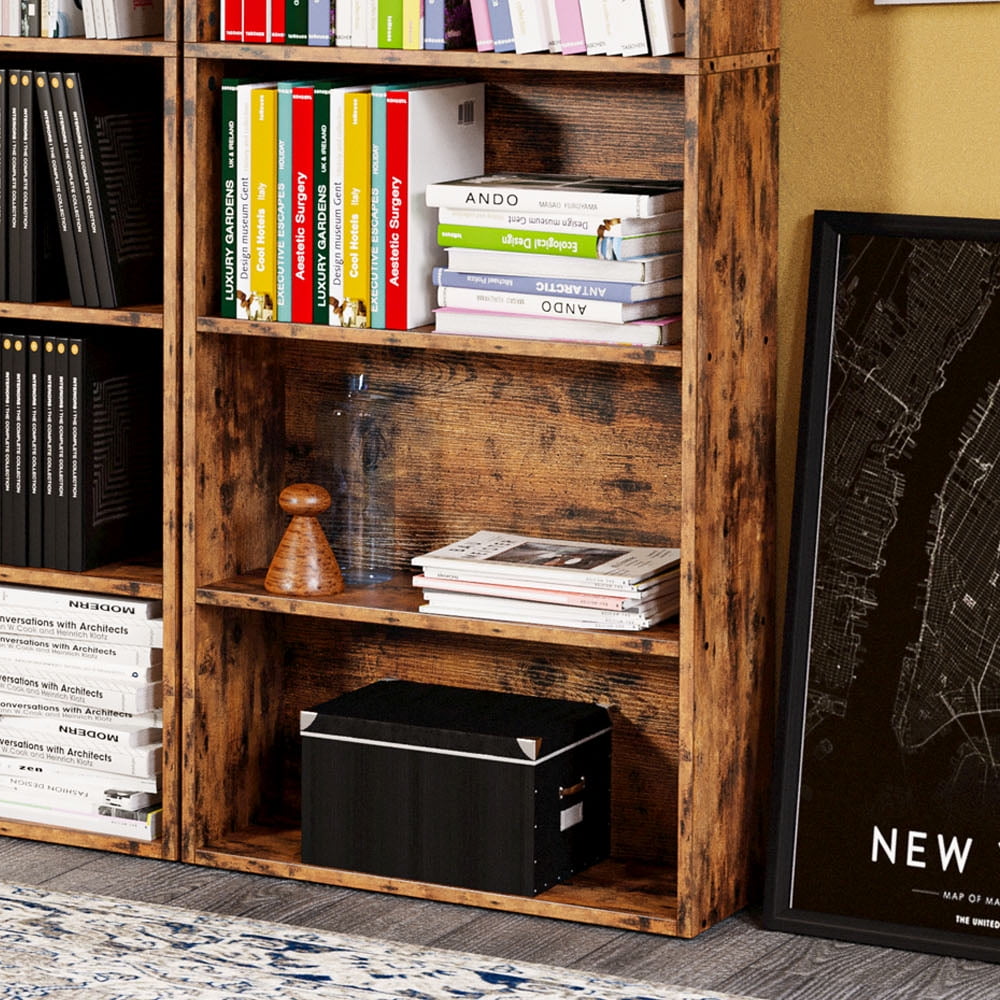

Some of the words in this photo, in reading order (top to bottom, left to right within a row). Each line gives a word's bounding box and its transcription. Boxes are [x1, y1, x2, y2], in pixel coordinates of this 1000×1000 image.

[81, 161, 90, 194] COMPLETE
[86, 195, 97, 233] COLLECTION
[241, 177, 249, 201] Gent
[295, 172, 308, 223] Surgery
[465, 192, 519, 206] ANDO
[225, 180, 234, 244] GARDENS
[390, 176, 402, 229] Surgery
[241, 204, 249, 247] museum
[318, 185, 327, 250] GARDENS
[371, 188, 379, 243] ESCAPES
[507, 215, 527, 225] Gent
[529, 217, 560, 226] museum
[562, 219, 588, 230] Design
[256, 209, 265, 244] Hotels
[501, 235, 531, 249] Design
[534, 238, 578, 253] Ecological
[256, 246, 265, 272] Cool
[295, 226, 306, 280] Aestetic
[389, 232, 400, 287] Aestetic
[225, 248, 234, 300] LUXURY
[241, 249, 251, 279] Design
[318, 254, 327, 307] LUXURY
[371, 247, 379, 313] EXECUTIVE
[536, 281, 606, 297] ANTARCTIC
[541, 300, 587, 316] ANDO
[69, 600, 135, 614] MODERN
[57, 617, 77, 629] with
[79, 621, 129, 634] Architects
[41, 679, 58, 691] with
[60, 682, 104, 699] Architects
[59, 725, 119, 742] MODERN
[46, 743, 65, 754] with
[67, 746, 113, 763] Architects
[19, 764, 43, 773] zen
[9, 778, 45, 791] DESIGN
[48, 784, 89, 798] FASHION
[871, 825, 973, 874] NEW
[942, 891, 965, 901] MAP
[968, 893, 981, 904] OF
[956, 914, 970, 925] THE
[972, 917, 1000, 929] UNITED
